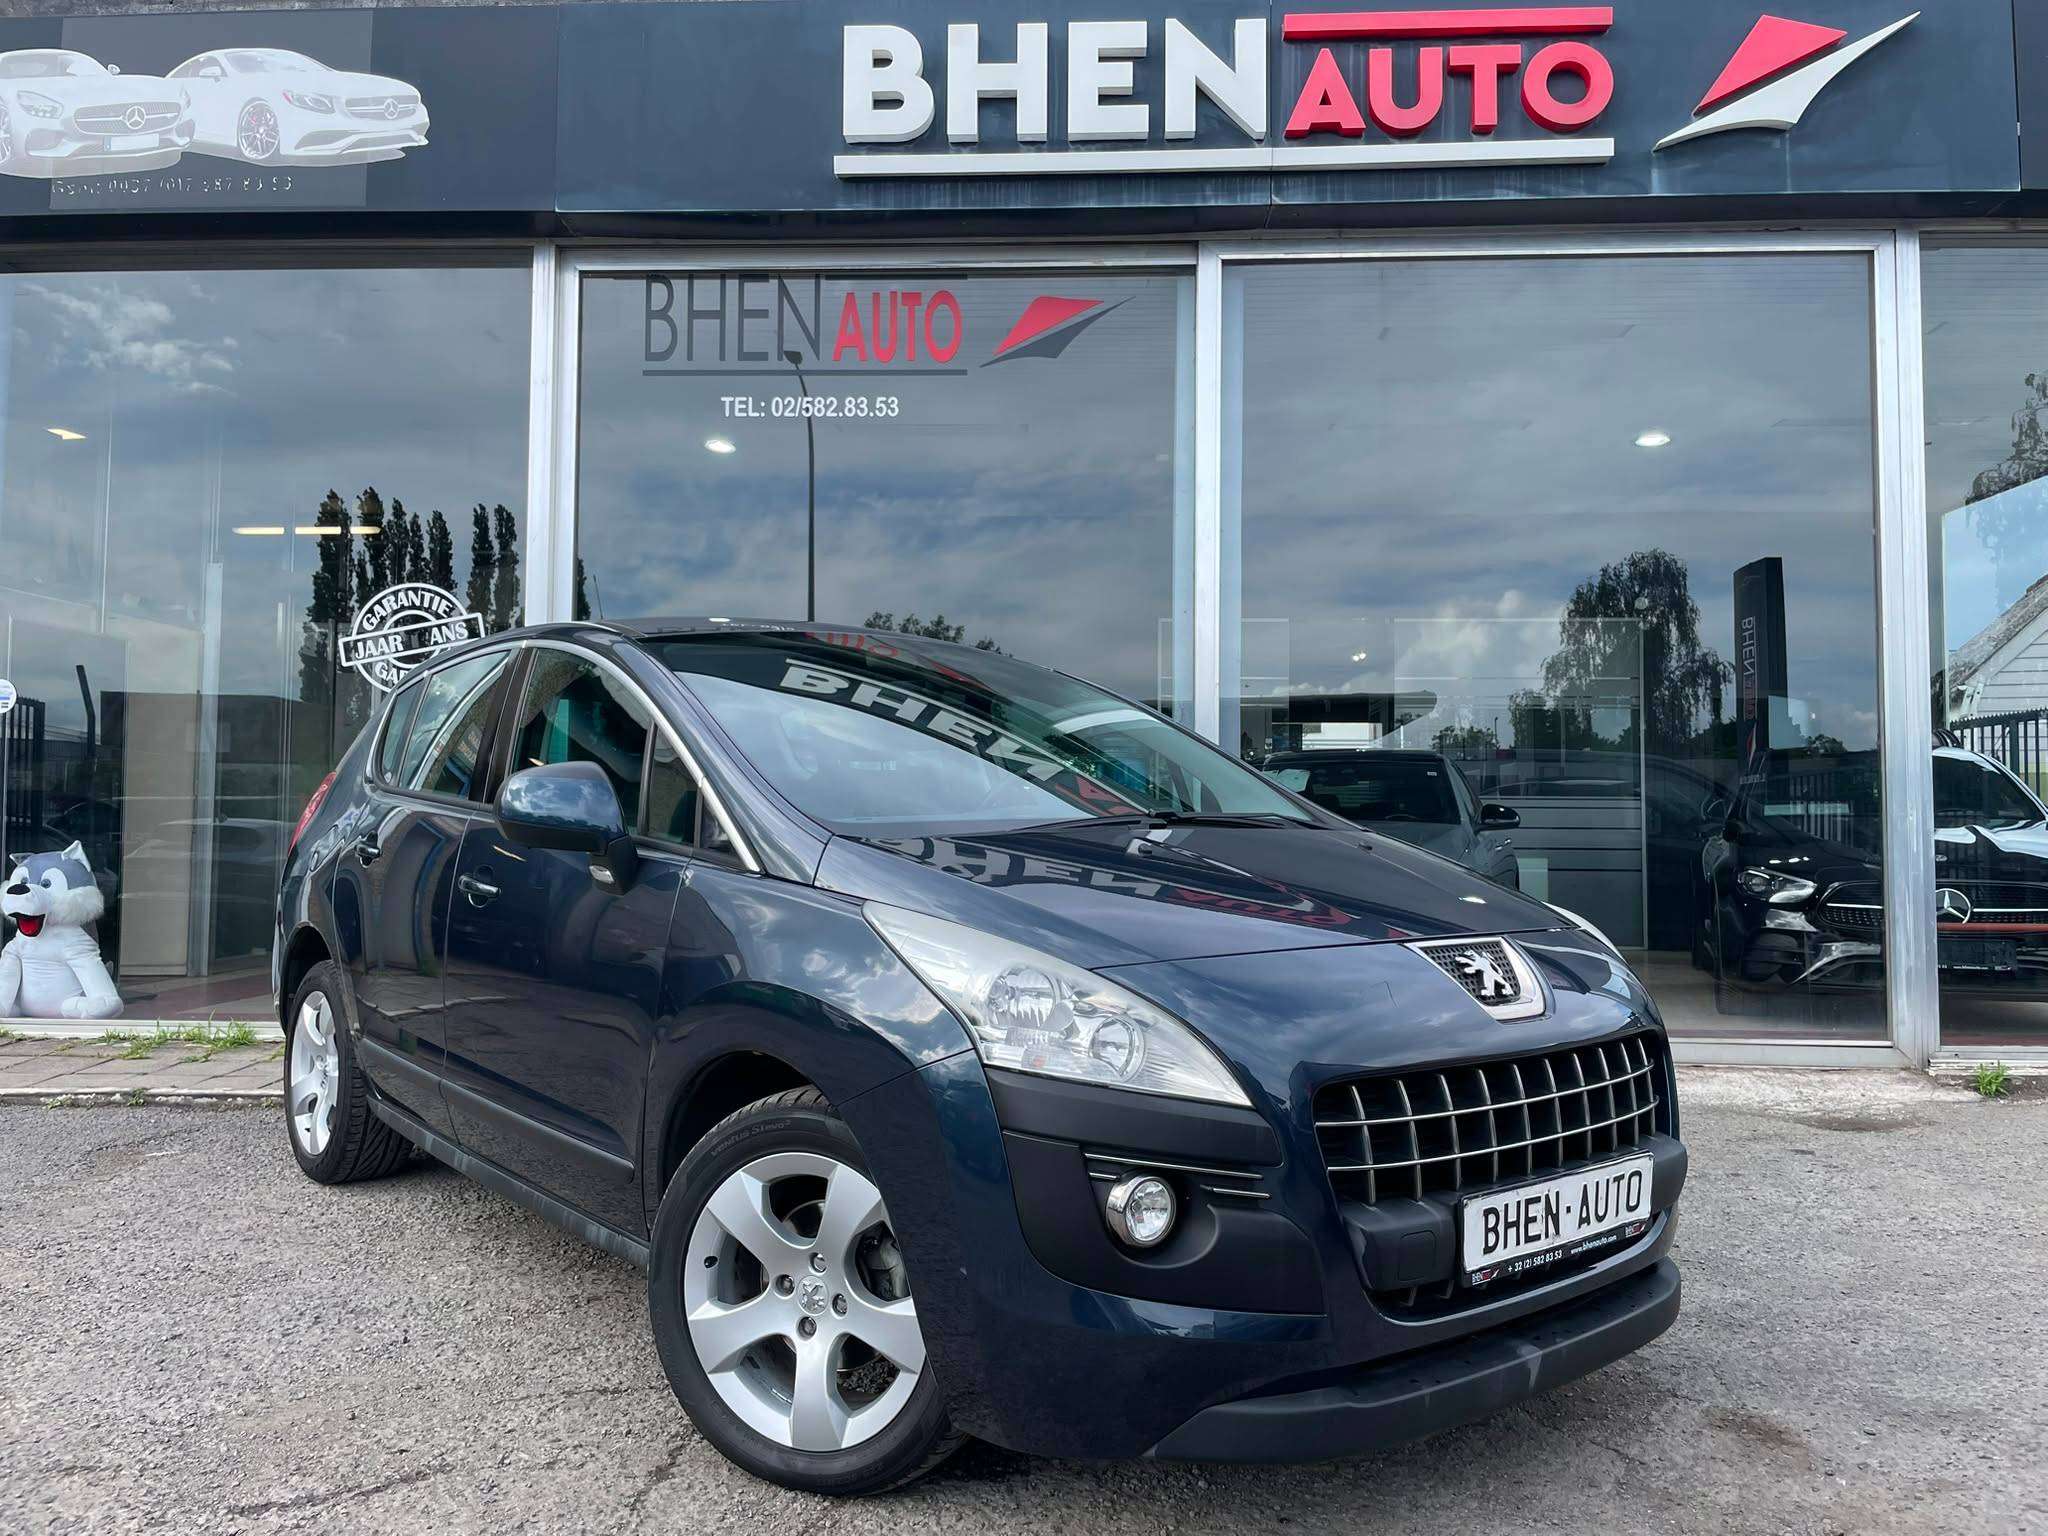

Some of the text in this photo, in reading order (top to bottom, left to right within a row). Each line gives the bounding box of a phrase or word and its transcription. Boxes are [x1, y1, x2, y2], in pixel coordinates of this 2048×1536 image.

[720, 396, 900, 418] TEL: 02/582.83.53
[362, 589, 453, 632] GARANTIE
[355, 621, 469, 660] JAAR ANS
